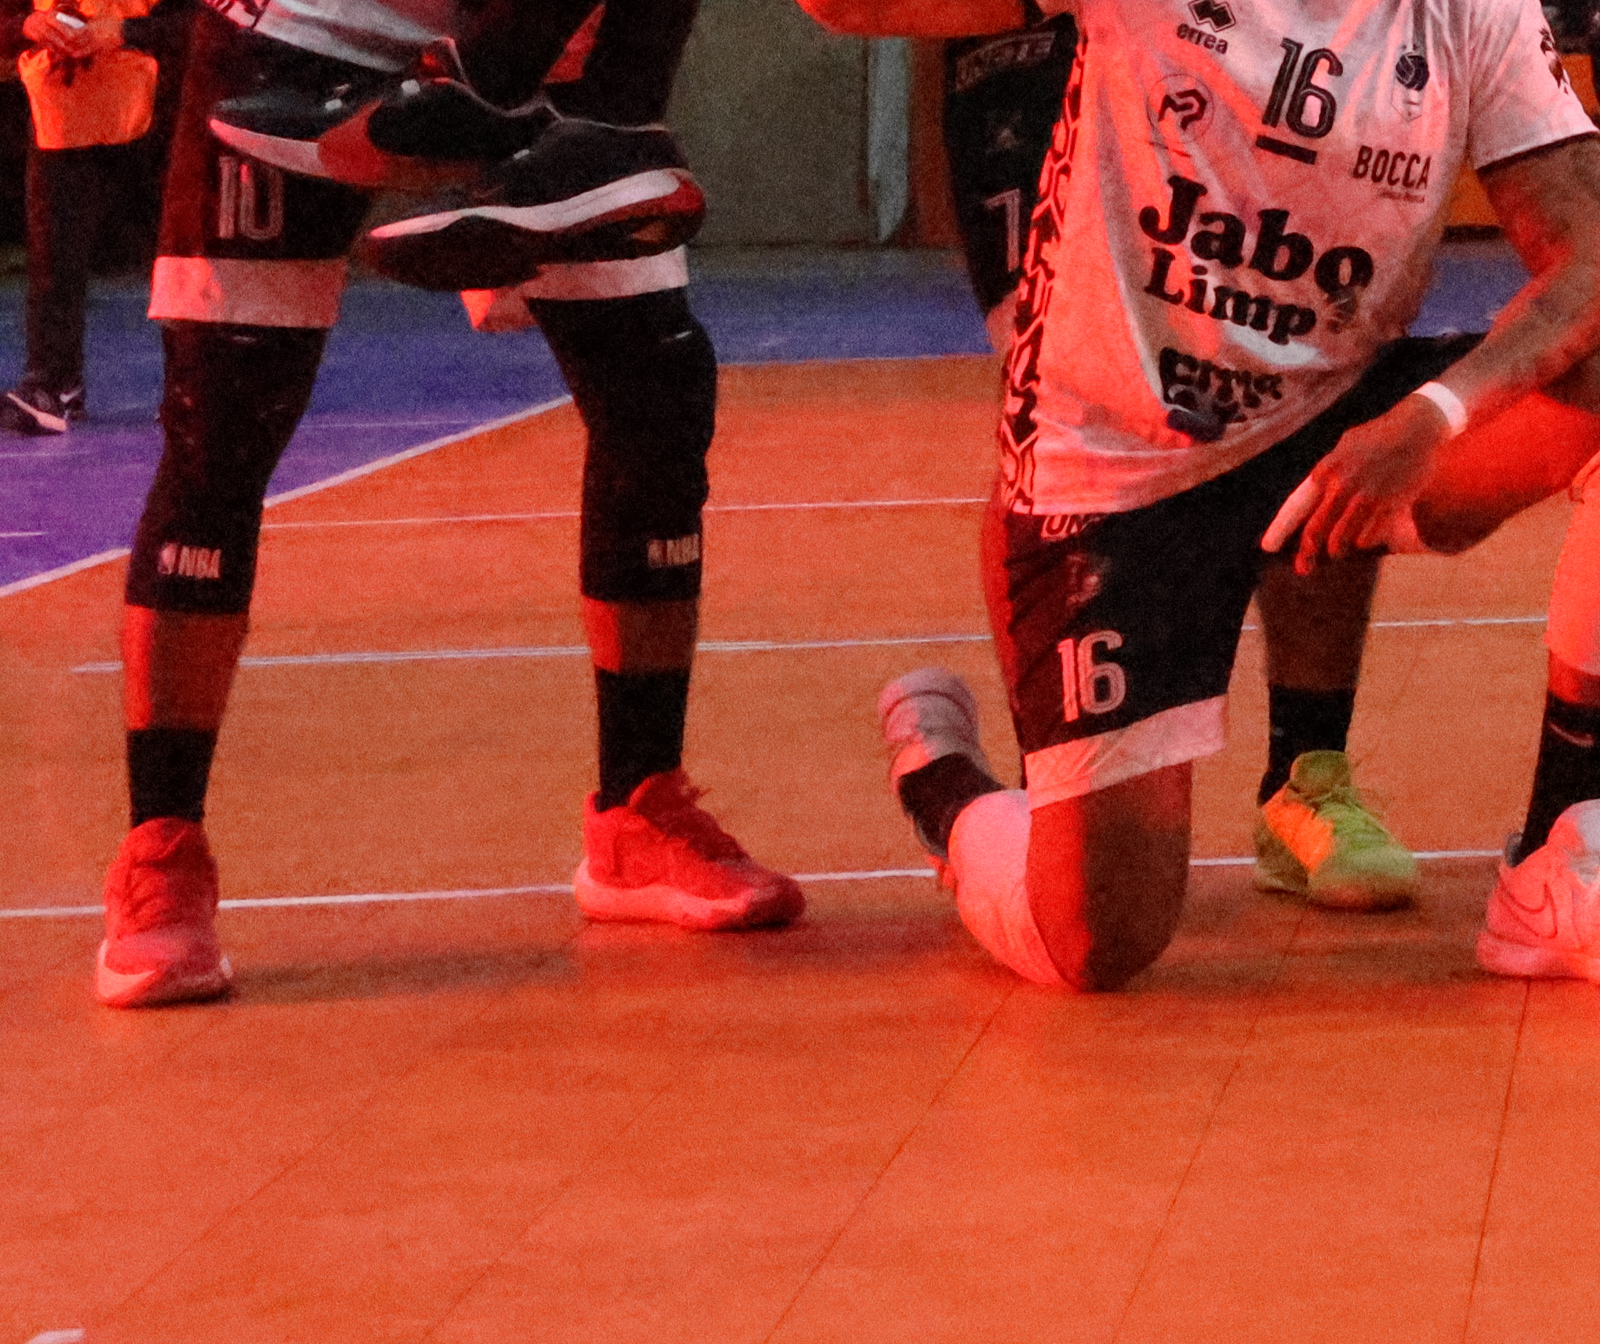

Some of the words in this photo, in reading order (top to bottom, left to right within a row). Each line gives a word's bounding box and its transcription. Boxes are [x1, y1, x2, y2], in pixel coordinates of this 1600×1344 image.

[1176, 22, 1228, 54] errea
[1262, 37, 1344, 139] 16
[218, 157, 285, 240] 10
[1353, 145, 1431, 190] BOCCA
[1139, 175, 1374, 294] Jabo
[1143, 247, 1318, 344] Limp
[1056, 631, 1127, 723] 16
